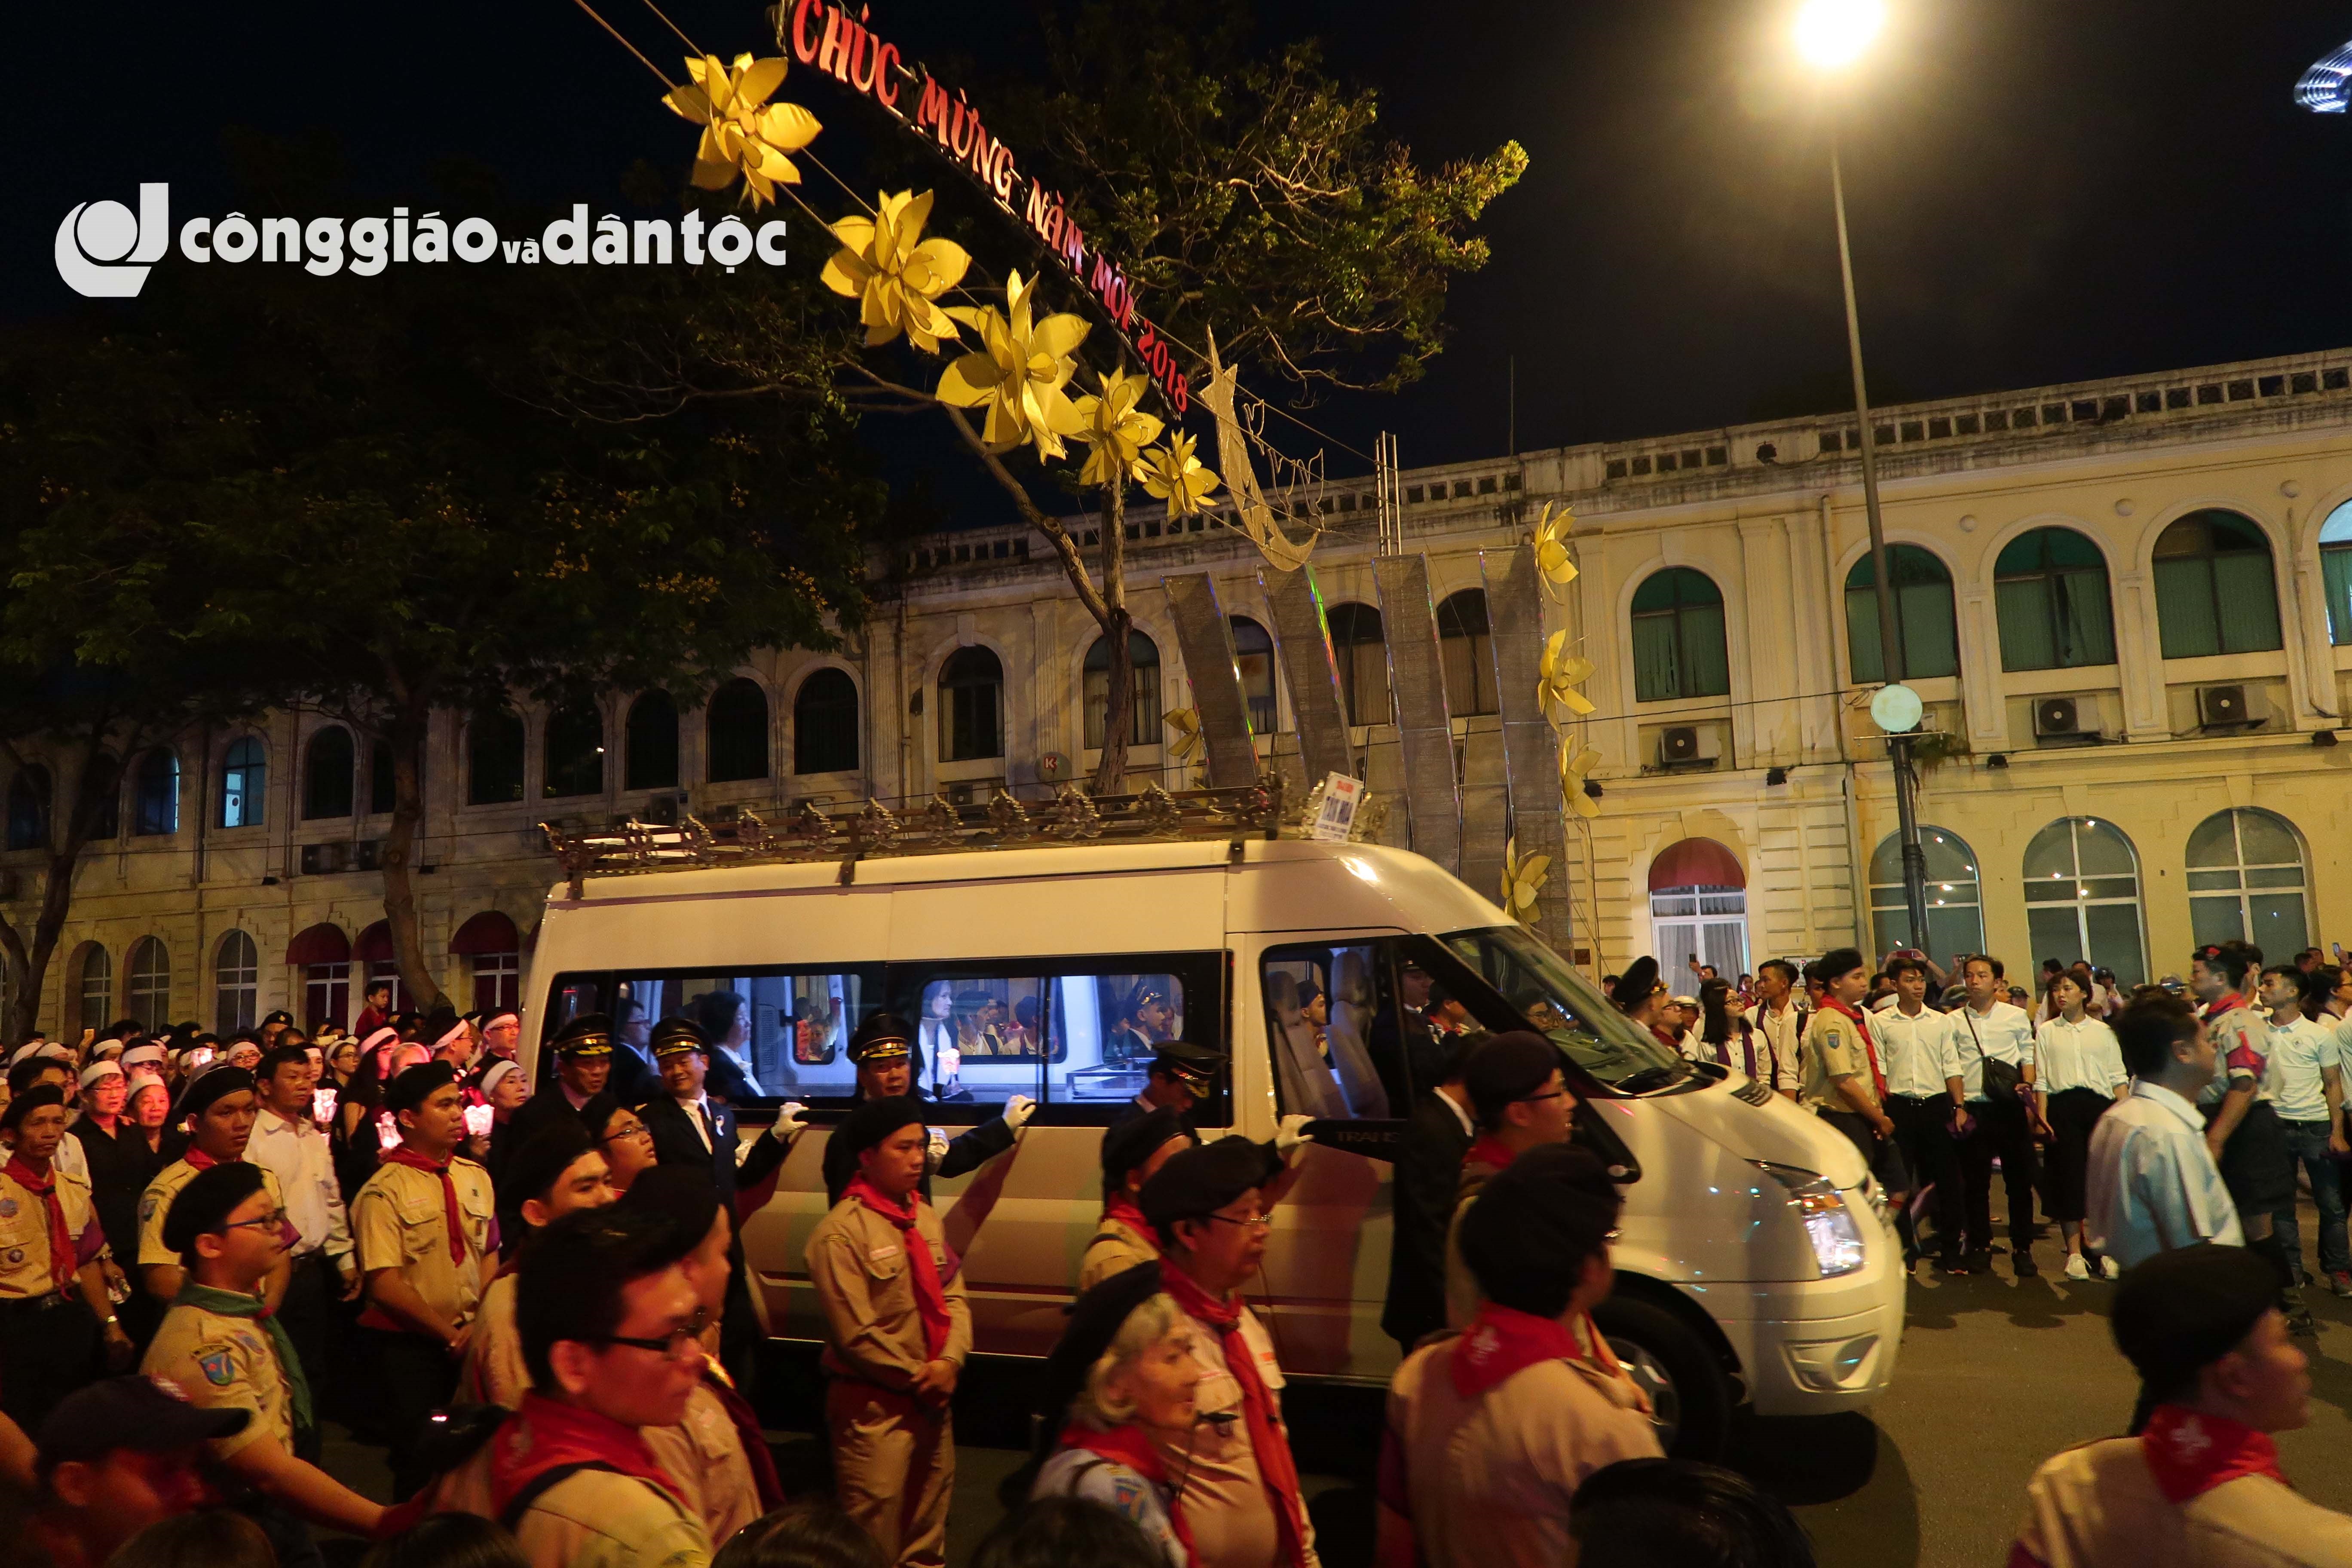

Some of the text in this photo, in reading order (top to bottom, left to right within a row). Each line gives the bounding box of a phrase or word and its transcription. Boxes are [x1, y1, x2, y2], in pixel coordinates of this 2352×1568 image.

[793, 0, 900, 106] CHÚC
[917, 75, 1014, 204] MỪNG
[1137, 318, 1188, 412] 2018
